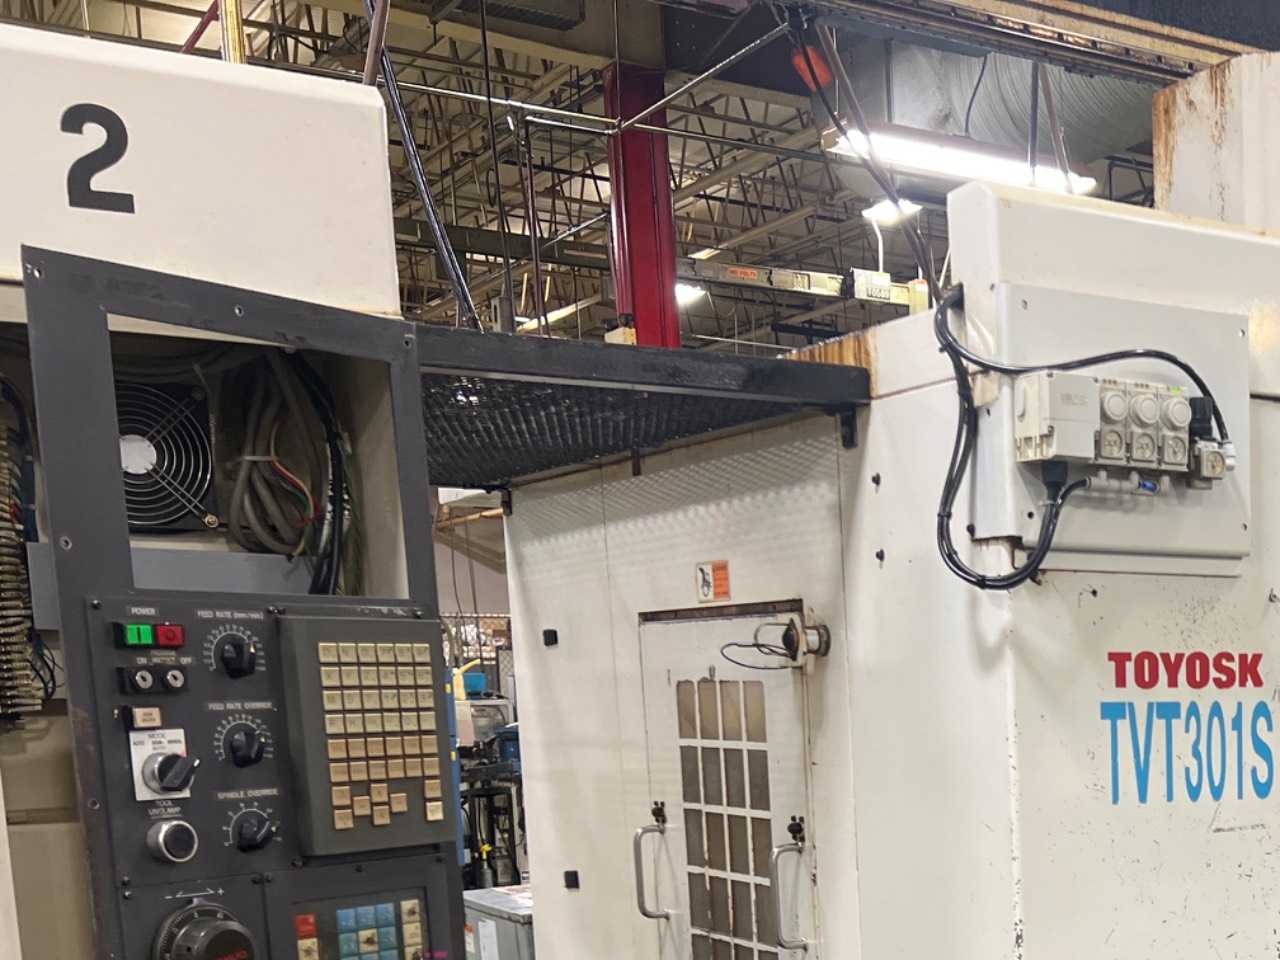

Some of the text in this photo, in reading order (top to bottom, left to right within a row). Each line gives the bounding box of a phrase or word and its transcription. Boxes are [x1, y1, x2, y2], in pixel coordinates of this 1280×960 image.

[60, 102, 136, 213] 2
[1107, 651, 1265, 690] TOYOSK
[1100, 700, 1275, 805] TVT301S
